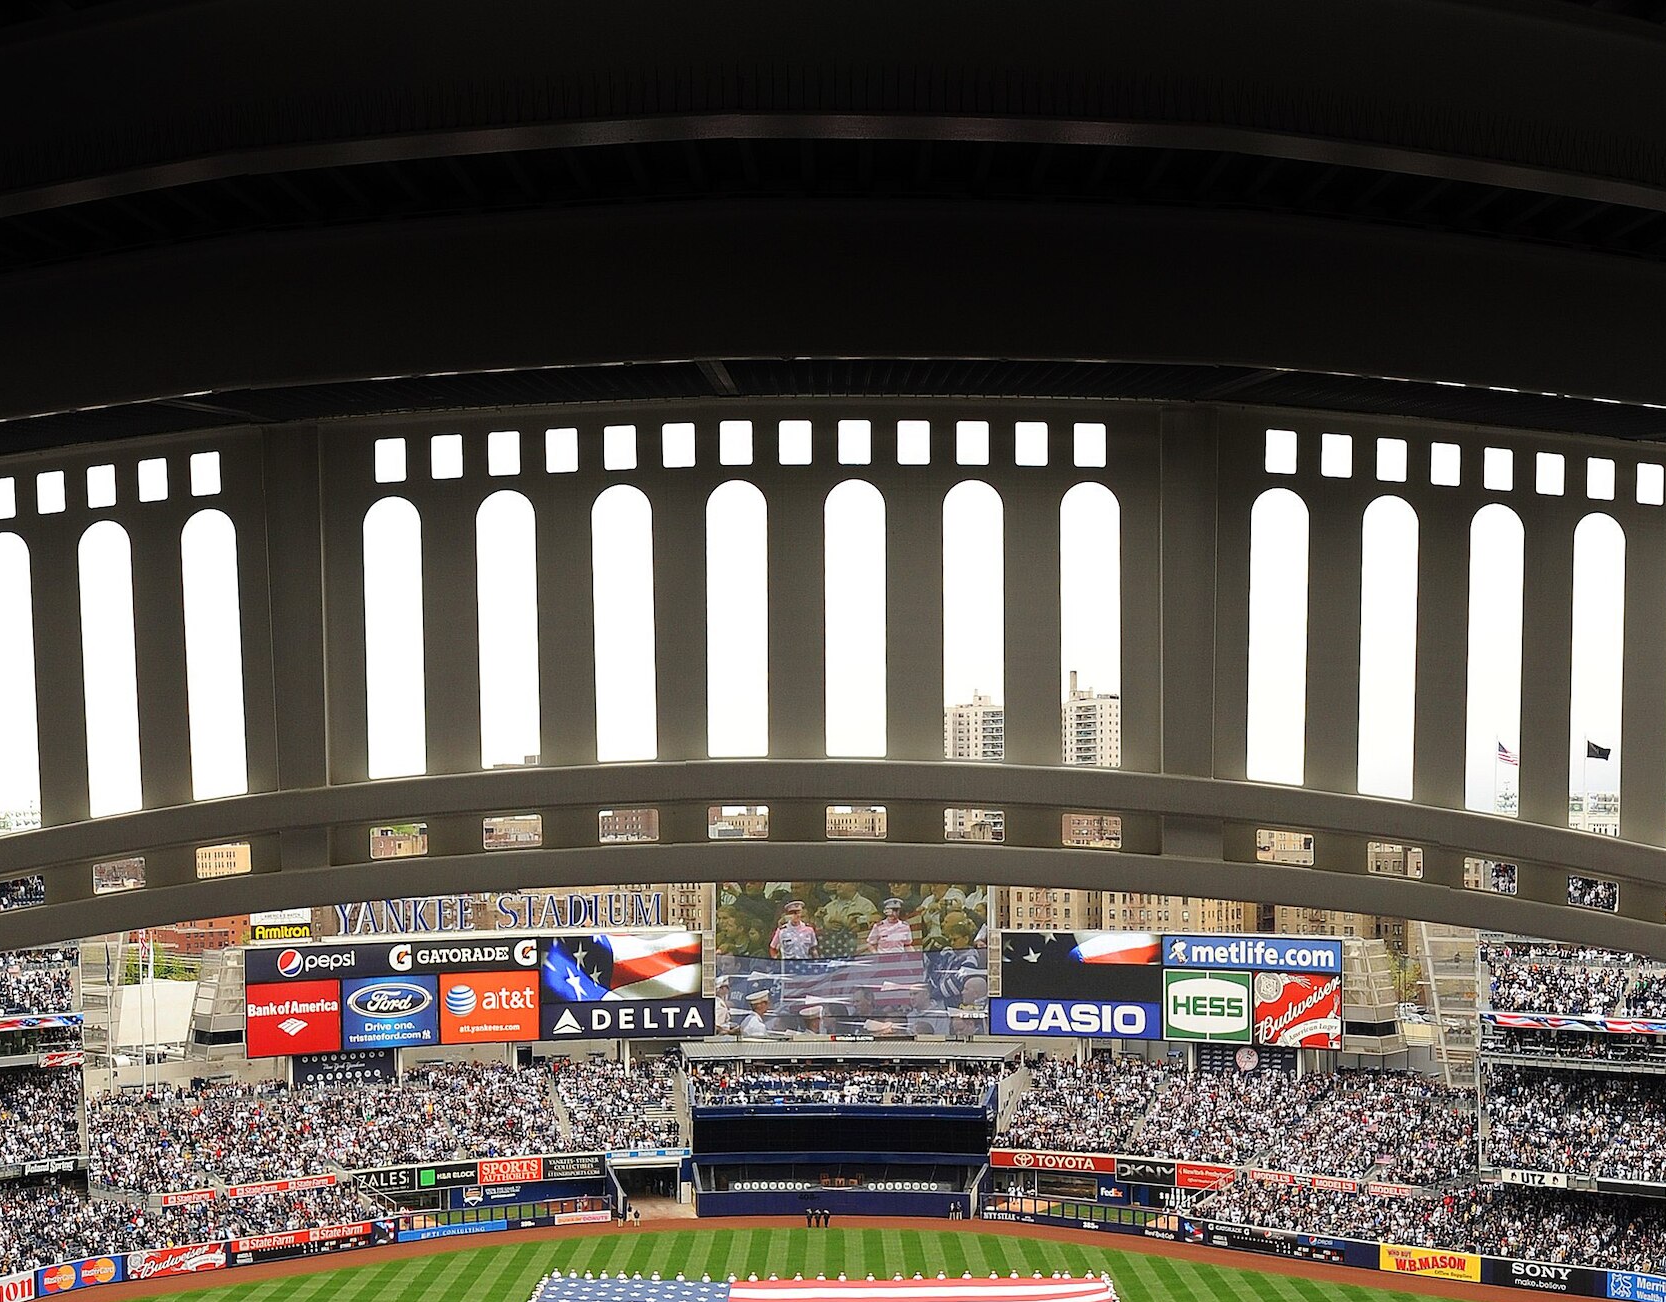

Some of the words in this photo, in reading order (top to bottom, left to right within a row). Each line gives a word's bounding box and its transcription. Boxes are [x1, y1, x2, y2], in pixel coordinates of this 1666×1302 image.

[334, 898, 475, 936] YANKEE
[496, 892, 664, 930] STADIUM
[255, 925, 310, 940] Armitron
[304, 950, 356, 973] pepsi
[416, 946, 509, 964] GATORADE
[1191, 940, 1334, 967] metlife.com
[367, 991, 412, 1012] Ford
[482, 986, 535, 1010] at&t
[1173, 995, 1244, 1018] HESS
[248, 1002, 279, 1018] Bank
[279, 1002, 290, 1014] of
[290, 999, 339, 1014] America
[1255, 976, 1341, 1044] Budweiser
[365, 1022, 392, 1031] Drive
[591, 1006, 705, 1031] DELTA
[1006, 1002, 1147, 1035] CASIO
[1288, 1025, 1319, 1042] American
[1319, 1024, 1339, 1034] Lager
[25, 1161, 49, 1176] Poland
[50, 1160, 74, 1173] Spring
[481, 1160, 539, 1175] SPORTS
[1036, 1155, 1095, 1171] TOYOTA
[358, 1170, 407, 1189] ZALES
[452, 1170, 476, 1178] BLOCK
[482, 1171, 540, 1183] AUTHORITY
[1521, 1172, 1546, 1185] UTZ
[1100, 1186, 1123, 1198] FedEx
[320, 1228, 341, 1239] State
[342, 1225, 363, 1236] Farm
[250, 1238, 272, 1249] State
[272, 1235, 295, 1246] Farm
[141, 1245, 210, 1279] Budweiser
[44, 1273, 75, 1285] MasterCard
[81, 1266, 114, 1278] MasterCard
[1511, 1262, 1572, 1281] SONY
